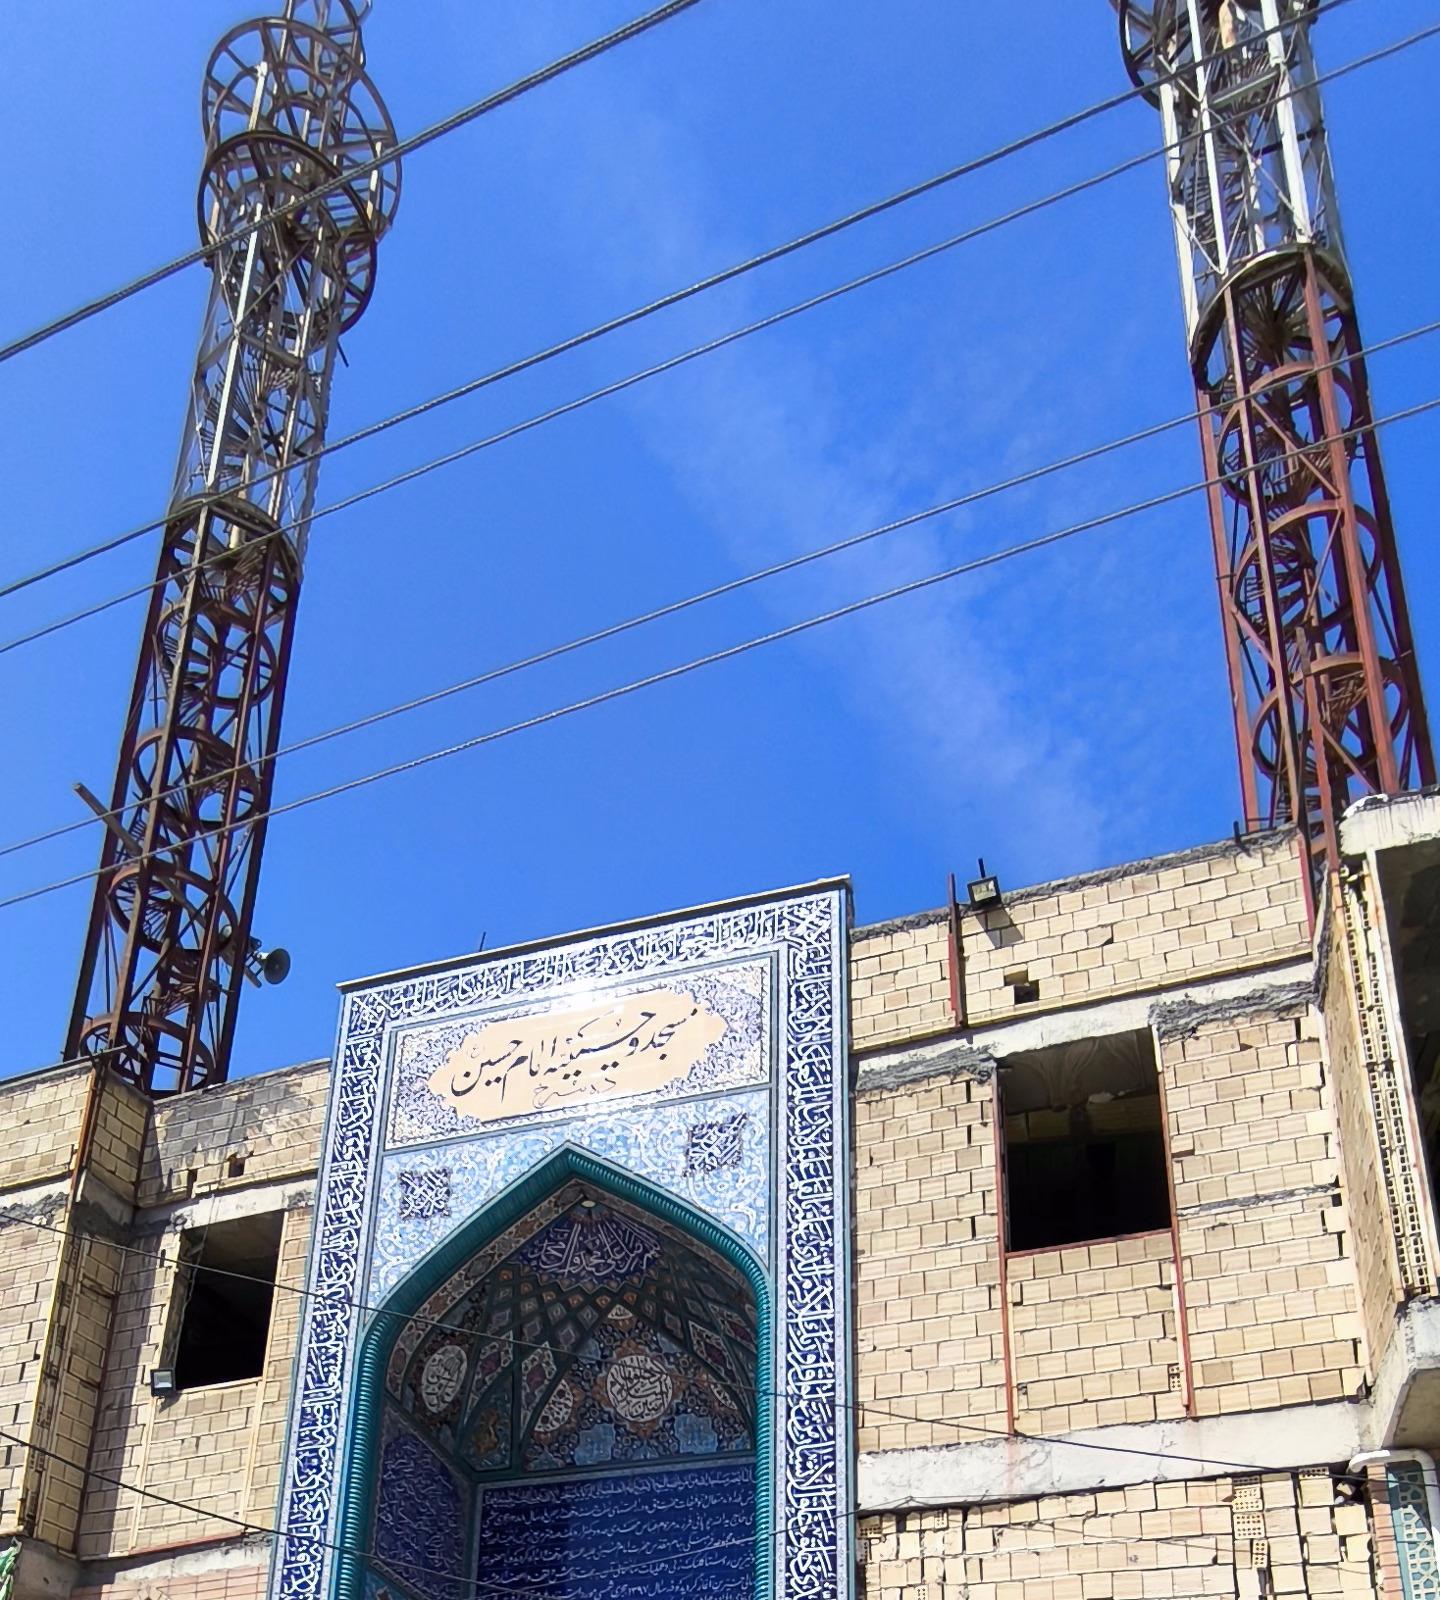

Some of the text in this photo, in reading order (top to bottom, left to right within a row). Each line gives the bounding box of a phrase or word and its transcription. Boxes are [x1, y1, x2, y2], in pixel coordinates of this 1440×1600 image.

[543, 1011, 657, 1080] حسینیه
[640, 1008, 699, 1061] مسجد
[450, 1039, 523, 1097] حسین
[501, 1036, 558, 1103] امام
